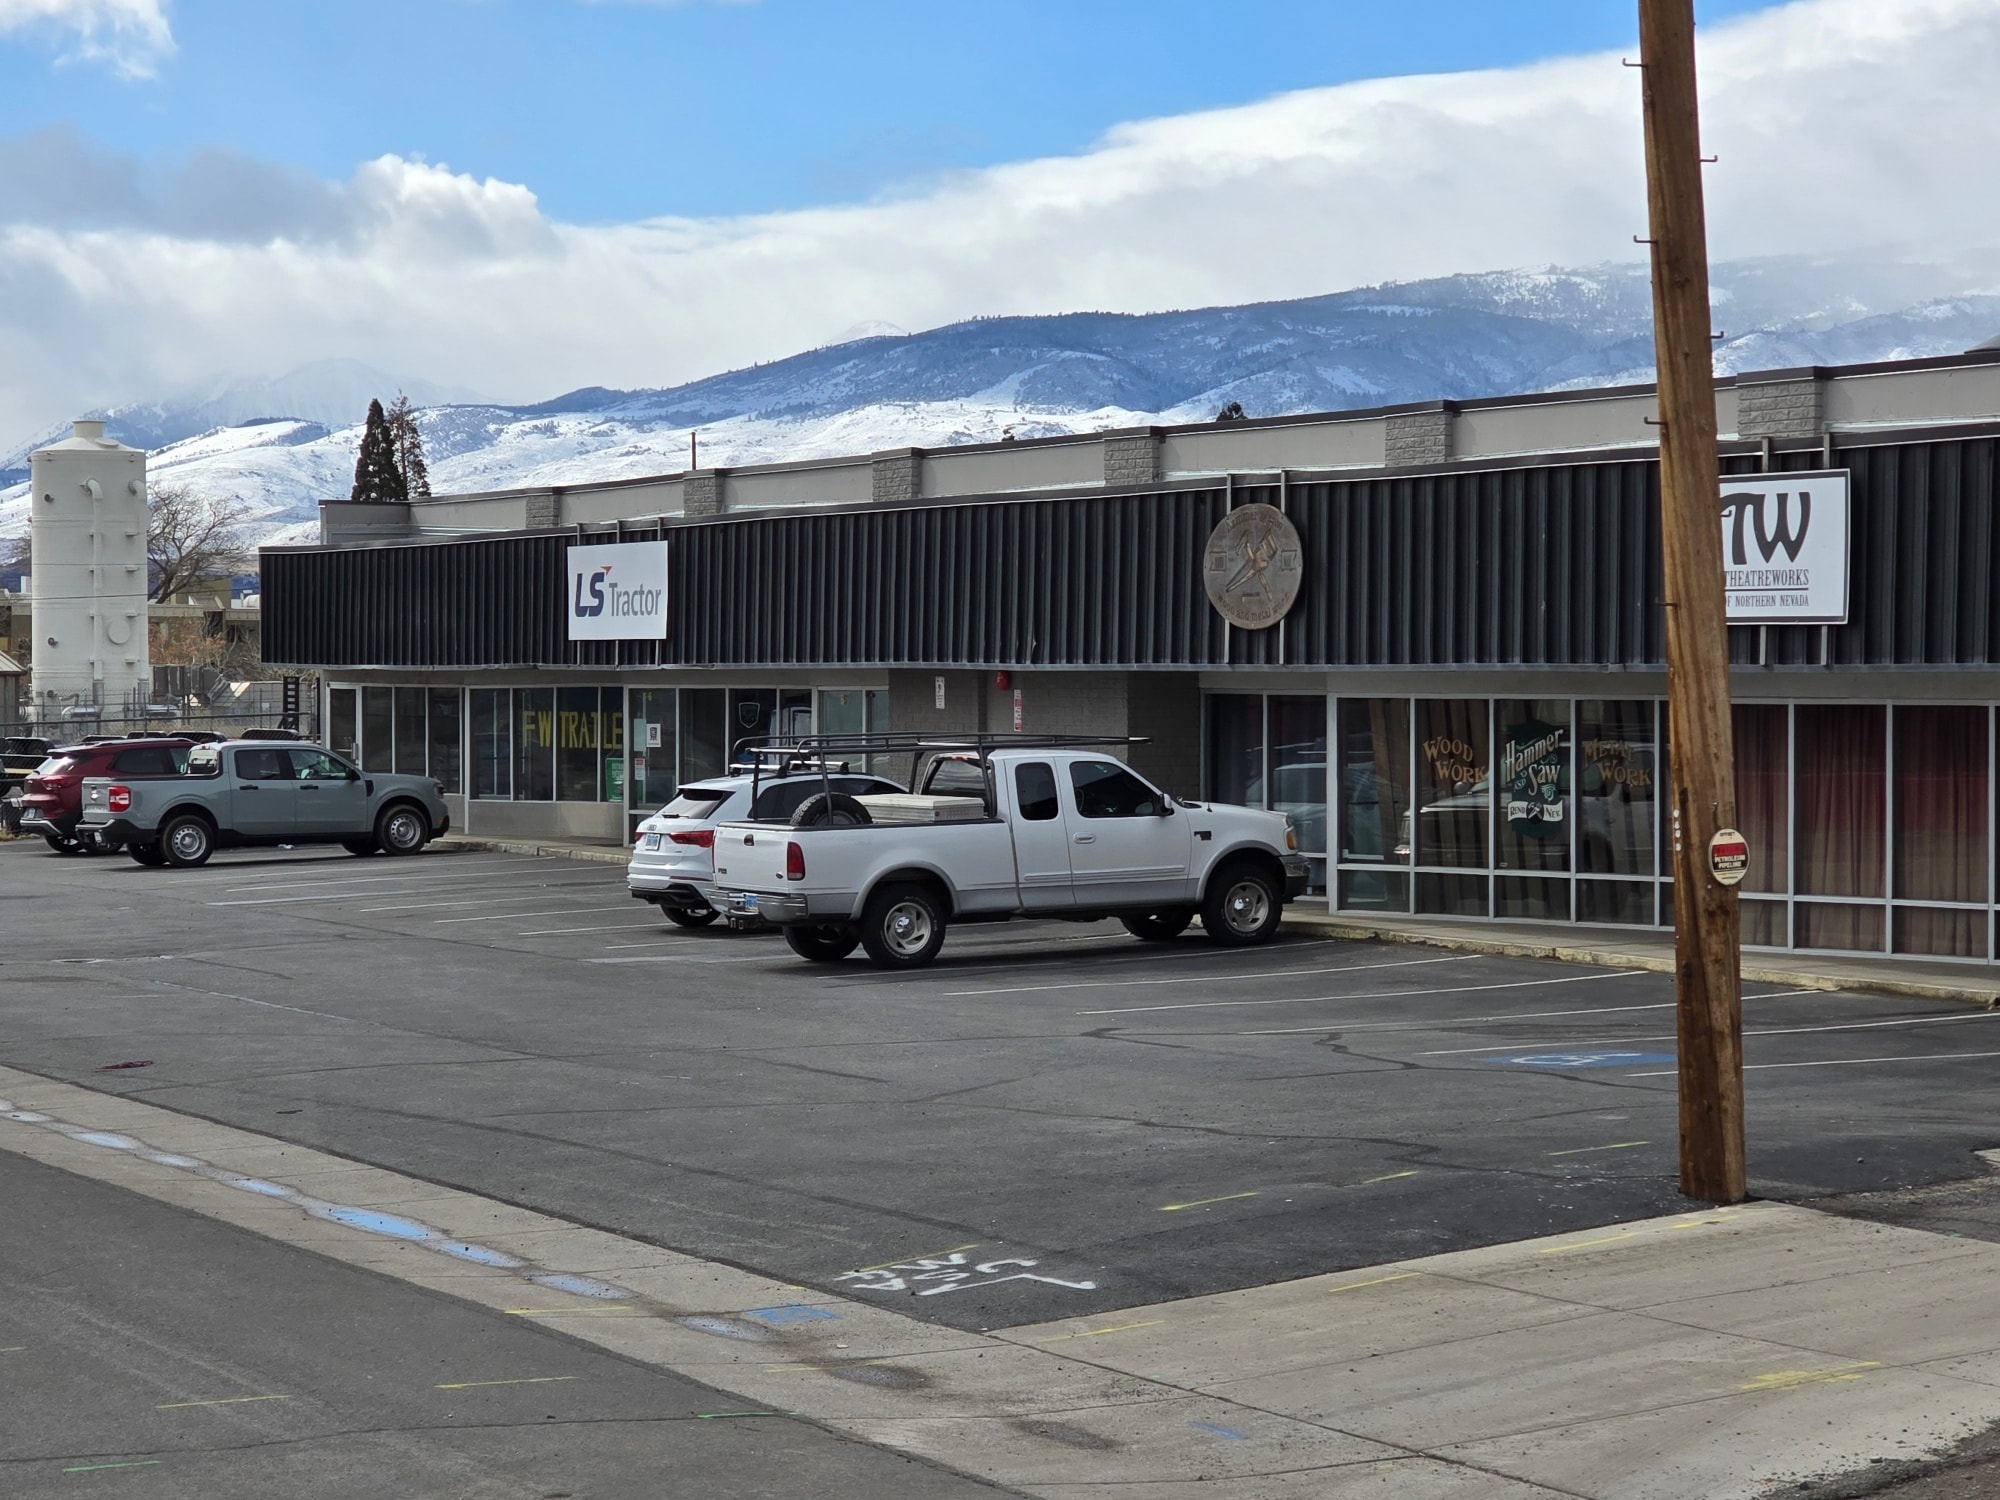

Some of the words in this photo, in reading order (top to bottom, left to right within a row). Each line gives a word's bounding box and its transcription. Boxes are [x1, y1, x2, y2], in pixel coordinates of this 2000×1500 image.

[575, 571, 606, 618] LS
[609, 583, 661, 617] Tractor
[1735, 595, 1777, 608] NORTHERN
[1779, 594, 1809, 607] NEVADA
[1422, 736, 1473, 762] WOOD
[1505, 729, 1564, 783] Hammer
[1435, 758, 1487, 783] WORK
[1528, 763, 1561, 796] Saw
[1598, 760, 1652, 786] WORK
